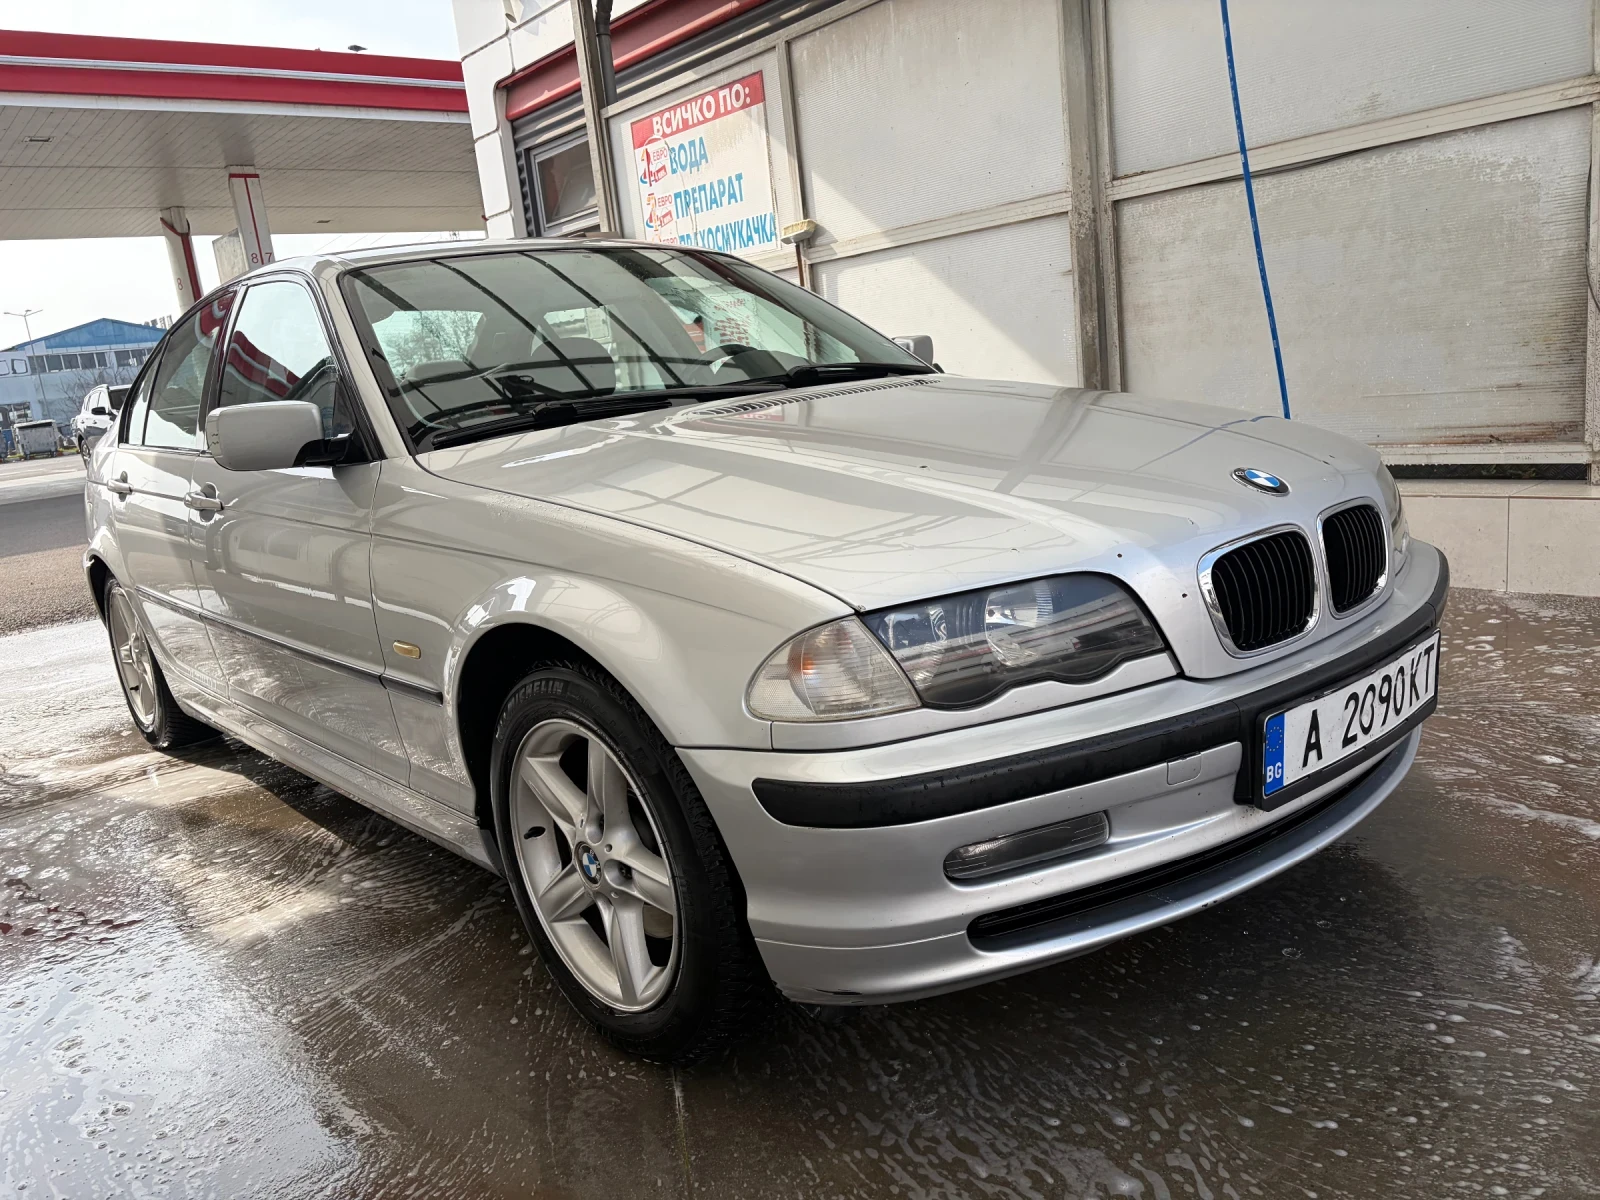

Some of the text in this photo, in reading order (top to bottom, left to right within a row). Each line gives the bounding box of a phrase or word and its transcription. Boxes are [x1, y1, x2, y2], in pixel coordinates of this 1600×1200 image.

[652, 83, 751, 137] ВСИЧКО ПО:
[652, 148, 668, 161] ЕВРО
[669, 136, 709, 175] ВОДА
[657, 194, 673, 207] ЕВРО
[673, 172, 744, 219] ПРЕПАРАТ
[250, 252, 273, 264] 8 7
[177, 278, 184, 291] 8
[507, 680, 564, 713] MICHELIN
[1302, 709, 1323, 768] A
[1266, 762, 1282, 783] BG
